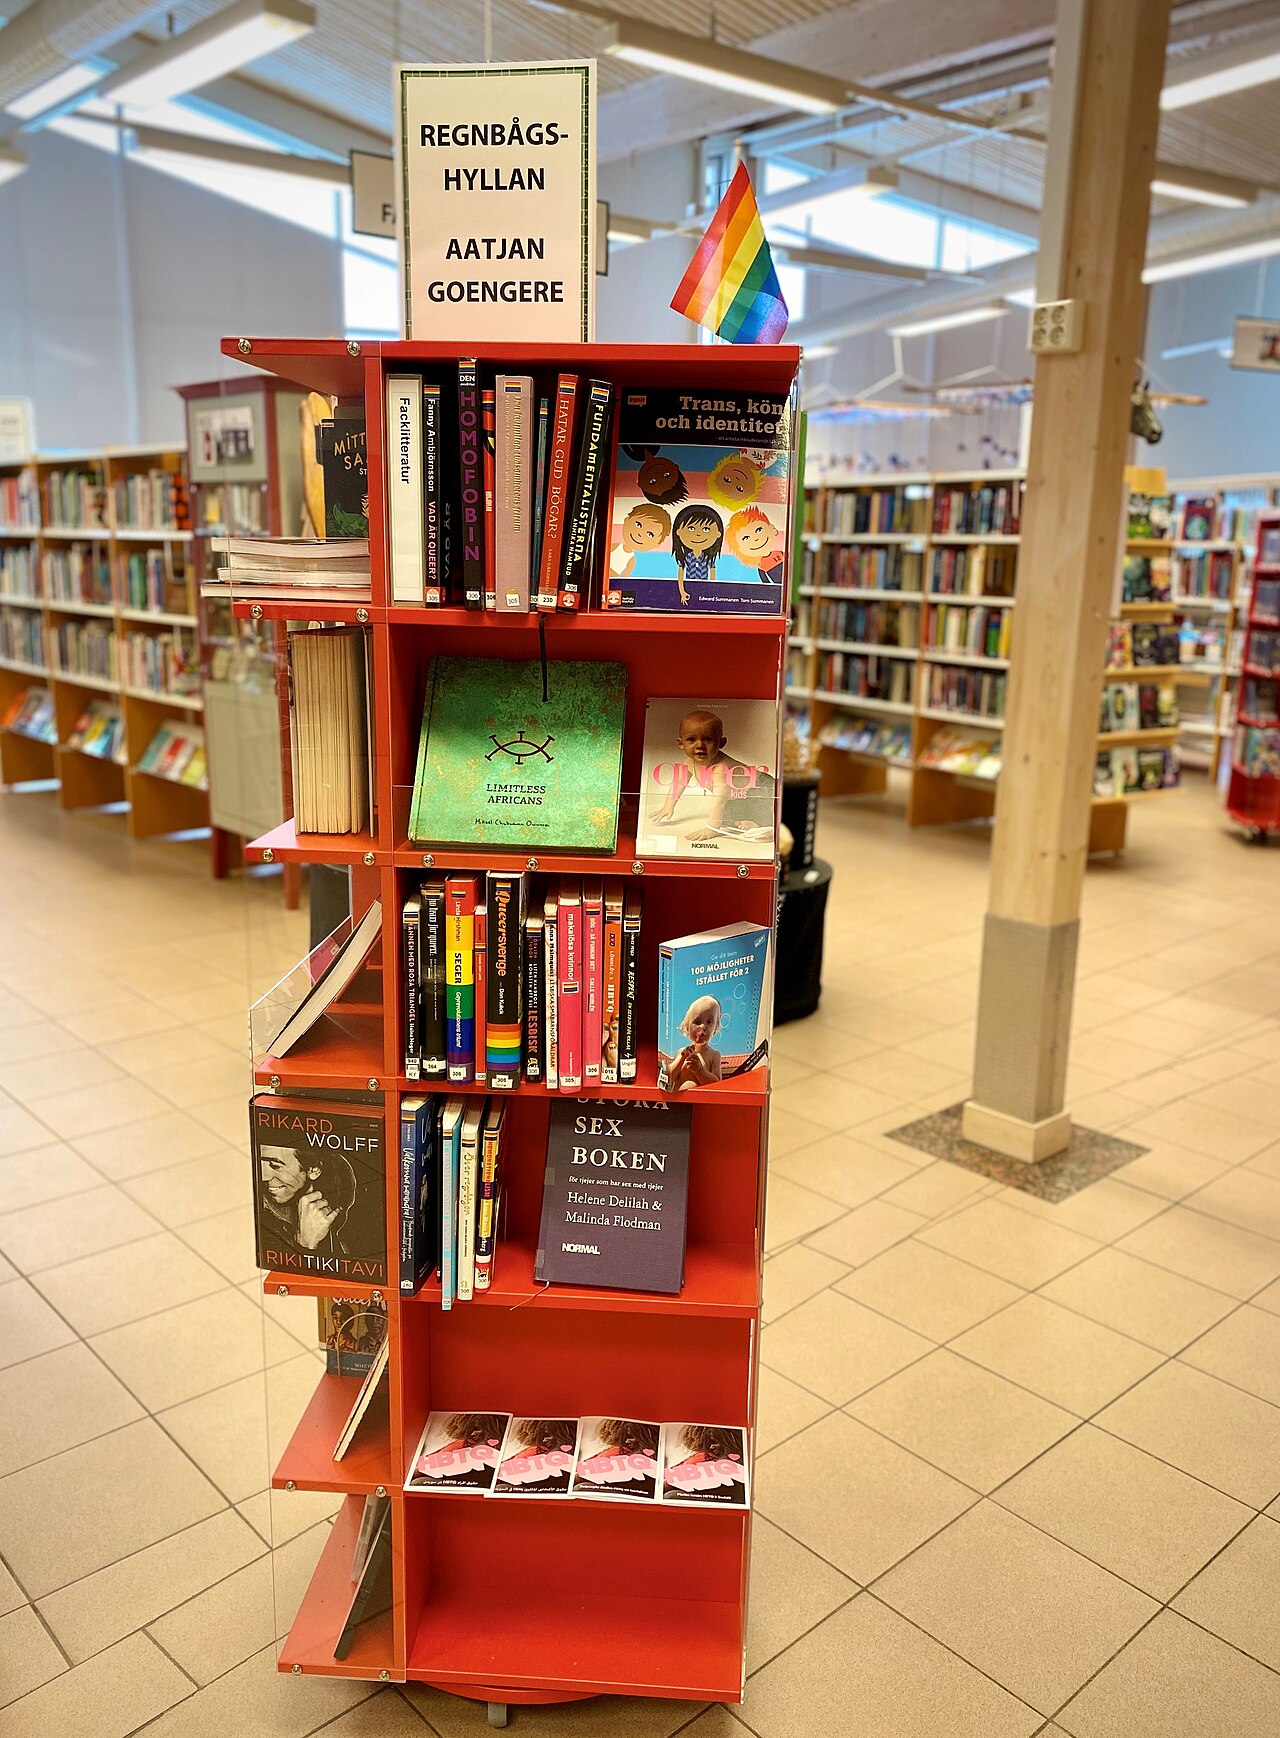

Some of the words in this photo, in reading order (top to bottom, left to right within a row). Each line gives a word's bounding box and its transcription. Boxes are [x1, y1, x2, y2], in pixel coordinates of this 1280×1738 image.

[420, 116, 569, 147] REGNBÅGS-
[443, 167, 546, 191] HYLLAN
[445, 237, 546, 262] AATJAN
[427, 280, 564, 304] GOENGERE
[459, 374, 476, 382] DEN
[427, 398, 436, 428] Fanny
[680, 396, 741, 415] Trans,
[747, 398, 783, 416] kön
[557, 399, 570, 444] HATAR
[656, 415, 691, 430] och
[695, 416, 784, 435] identitet
[399, 397, 411, 484] Facklitteratur
[344, 453, 368, 470] SA
[427, 430, 437, 492] Ambjörnsson
[554, 449, 565, 479] GUD
[459, 391, 479, 561] HOMOFOBIN
[573, 404, 604, 562] FUNDAMENTALISTERNA
[428, 501, 437, 521] VAD
[548, 486, 563, 539] BÖGAR?
[428, 525, 438, 539] ÄR
[569, 518, 578, 545] ANNIKA
[428, 542, 437, 580] QUEER?
[566, 546, 574, 576] HAMRUD
[773, 555, 782, 563] 12
[486, 784, 546, 794] LIMITLESS
[653, 762, 770, 800] queer
[487, 796, 543, 805] AFRICANS
[730, 789, 748, 799] kids
[496, 891, 511, 977] Queersverige
[567, 914, 575, 951] makalösa
[454, 953, 462, 984] SEGER
[567, 952, 575, 981] kvinnor
[690, 967, 705, 976] 100
[706, 955, 755, 973] MÖJLIGHETER
[696, 972, 729, 986] ISTÄLLET
[730, 969, 744, 979] FÖR
[606, 984, 614, 1013] HBTQ
[528, 1010, 538, 1053] LESBISK
[258, 1113, 333, 1134] RIKARD
[574, 1116, 624, 1137] SEX
[306, 1132, 380, 1153] WOLFF
[571, 1146, 668, 1173] BOKEN
[580, 1178, 596, 1186] tjejer
[610, 1179, 621, 1187] har
[633, 1182, 646, 1190] med
[647, 1183, 664, 1192] tjejer
[567, 1192, 606, 1206] Helene
[608, 1196, 649, 1210] Delilah
[652, 1200, 663, 1211] &
[565, 1211, 610, 1226] Malinda
[613, 1215, 662, 1231] Flodman
[562, 1243, 601, 1255] NORMAL
[266, 1250, 383, 1278] RIKITIKITAVI
[418, 1447, 494, 1471] HBTQ
[500, 1454, 570, 1477] HBTQ
[576, 1454, 653, 1476] HBTQ
[664, 1459, 739, 1483] HBTQ
